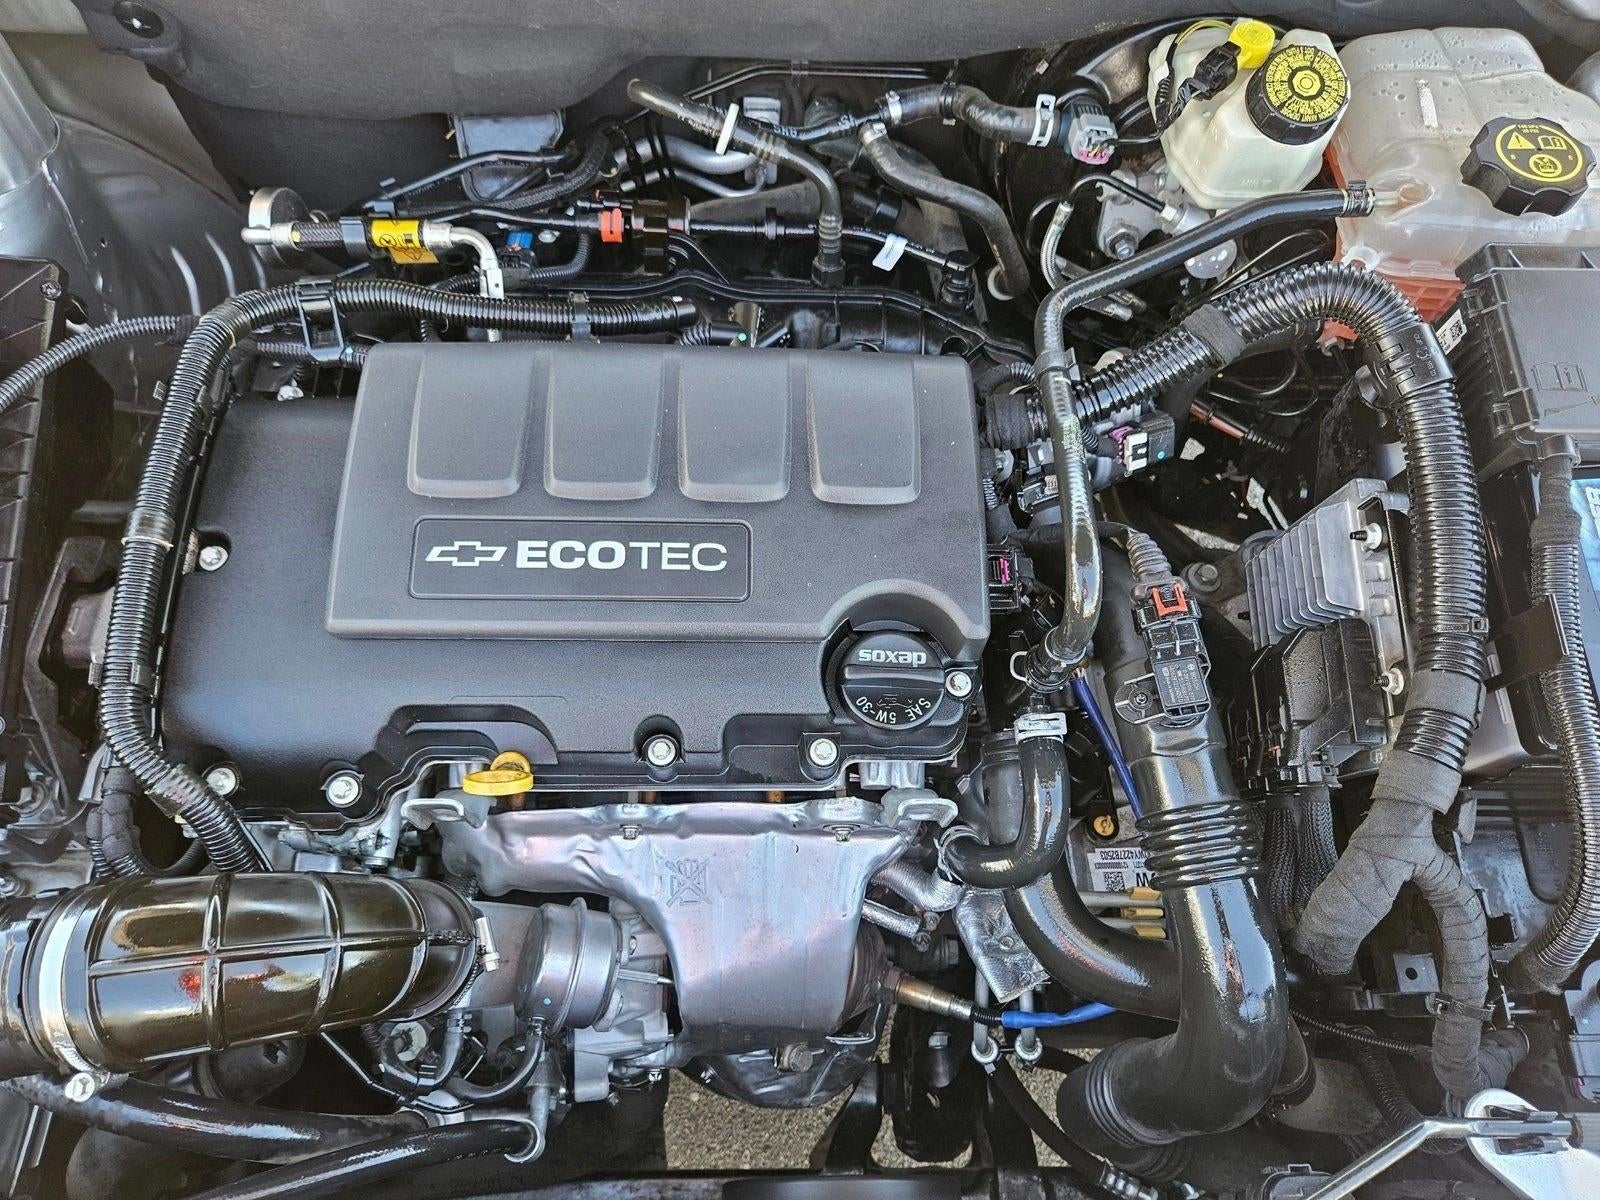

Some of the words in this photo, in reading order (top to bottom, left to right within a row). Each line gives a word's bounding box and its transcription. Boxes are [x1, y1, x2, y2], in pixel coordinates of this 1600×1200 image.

[516, 540, 728, 571] ECOTEC
[859, 649, 927, 667] dexos
[856, 696, 896, 724] 5W-30
[905, 697, 931, 721] SAE
